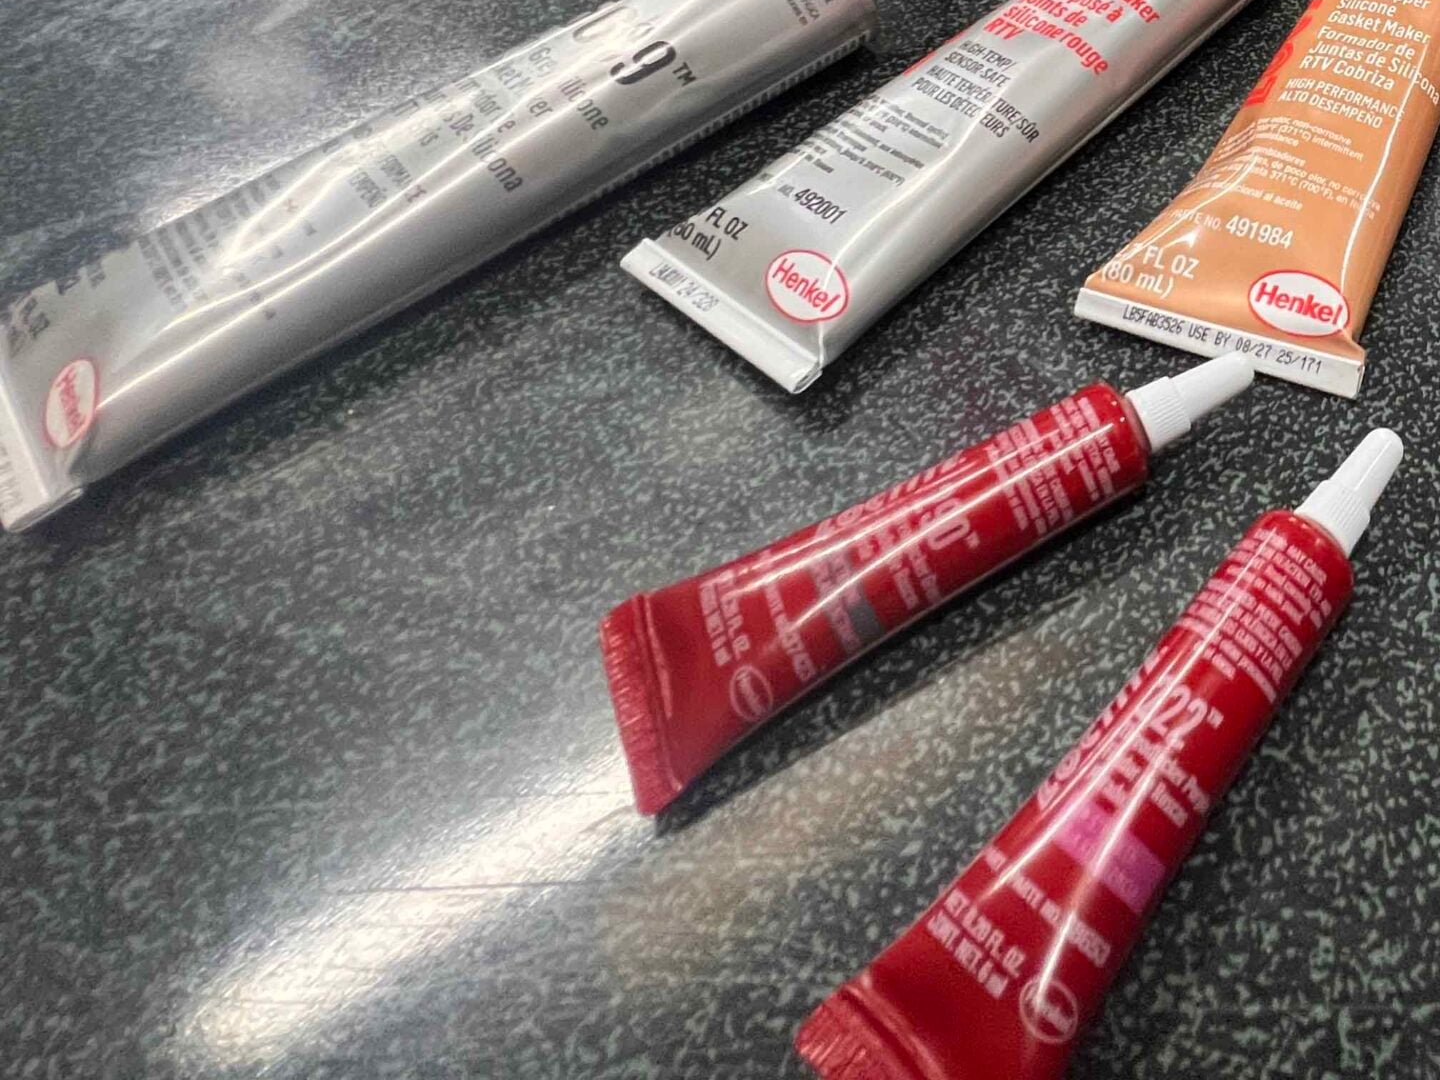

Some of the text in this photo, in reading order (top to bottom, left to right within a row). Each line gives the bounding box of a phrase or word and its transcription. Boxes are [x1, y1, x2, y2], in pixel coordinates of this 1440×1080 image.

[983, 18, 1026, 40] RTV
[1066, 10, 1088, 27] de
[1327, 10, 1432, 44] Gasket Maker
[1003, 5, 1110, 75] silicone rouge
[1316, 26, 1416, 60] Formador de
[926, 66, 958, 88] HAUTE
[1299, 55, 1396, 92] RTV Cobriza
[1308, 41, 1440, 107] Juntas de Silicona
[912, 78, 953, 108] POUR LES
[1278, 90, 1383, 129] ALTO DESEMPEÑO
[1285, 78, 1405, 122] HIGH PERFORMANCE
[705, 207, 748, 240] FL OZ
[794, 188, 848, 225] 492001
[691, 233, 721, 261] mL)
[1204, 214, 1294, 249] NO. 491984
[1142, 247, 1200, 280] FL OZ
[772, 258, 841, 312] Henkel
[1136, 273, 1174, 299] mL)
[1255, 282, 1343, 325] Henkel
[1188, 327, 1208, 342] USE
[1214, 332, 1232, 347] BY
[1235, 338, 1273, 360] 08/27
[1276, 351, 1322, 374] 25/171
